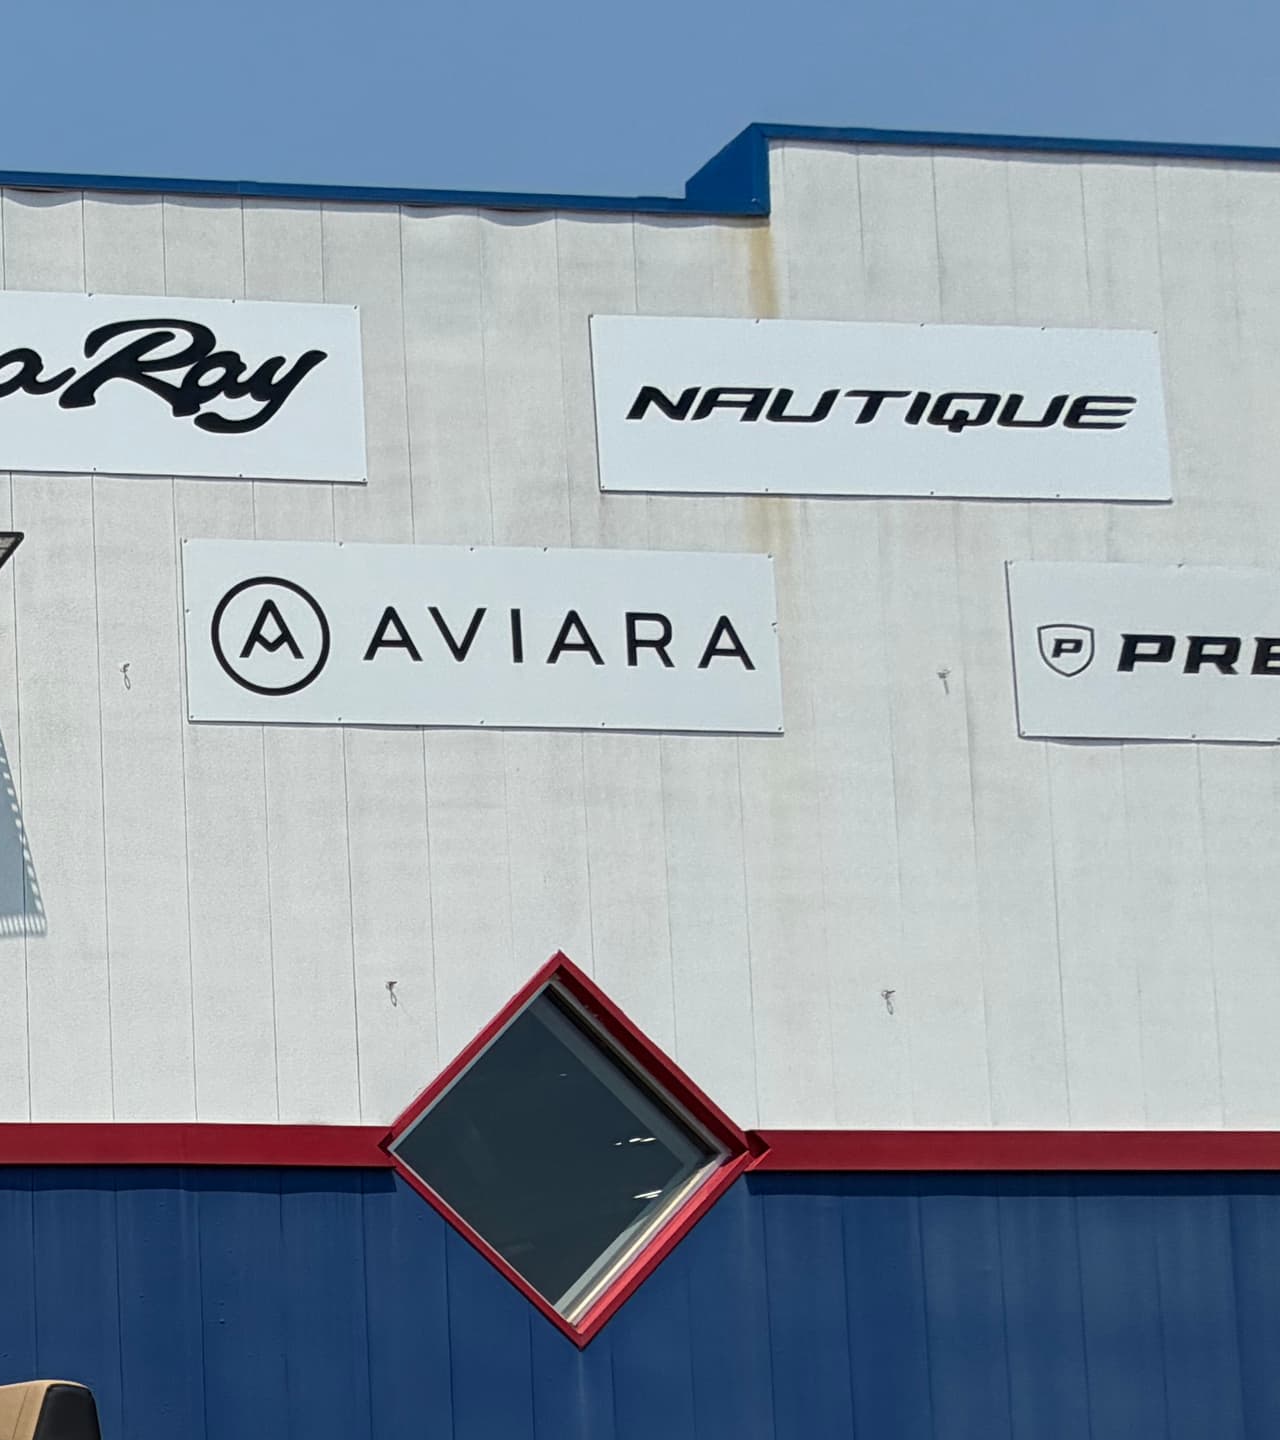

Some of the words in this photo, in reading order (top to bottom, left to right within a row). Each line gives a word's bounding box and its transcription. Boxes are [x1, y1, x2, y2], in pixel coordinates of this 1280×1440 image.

[57, 317, 329, 434] Ray
[625, 385, 1138, 433] NAUTIQUE
[363, 606, 756, 671] AVIARA
[1051, 638, 1083, 658] P
